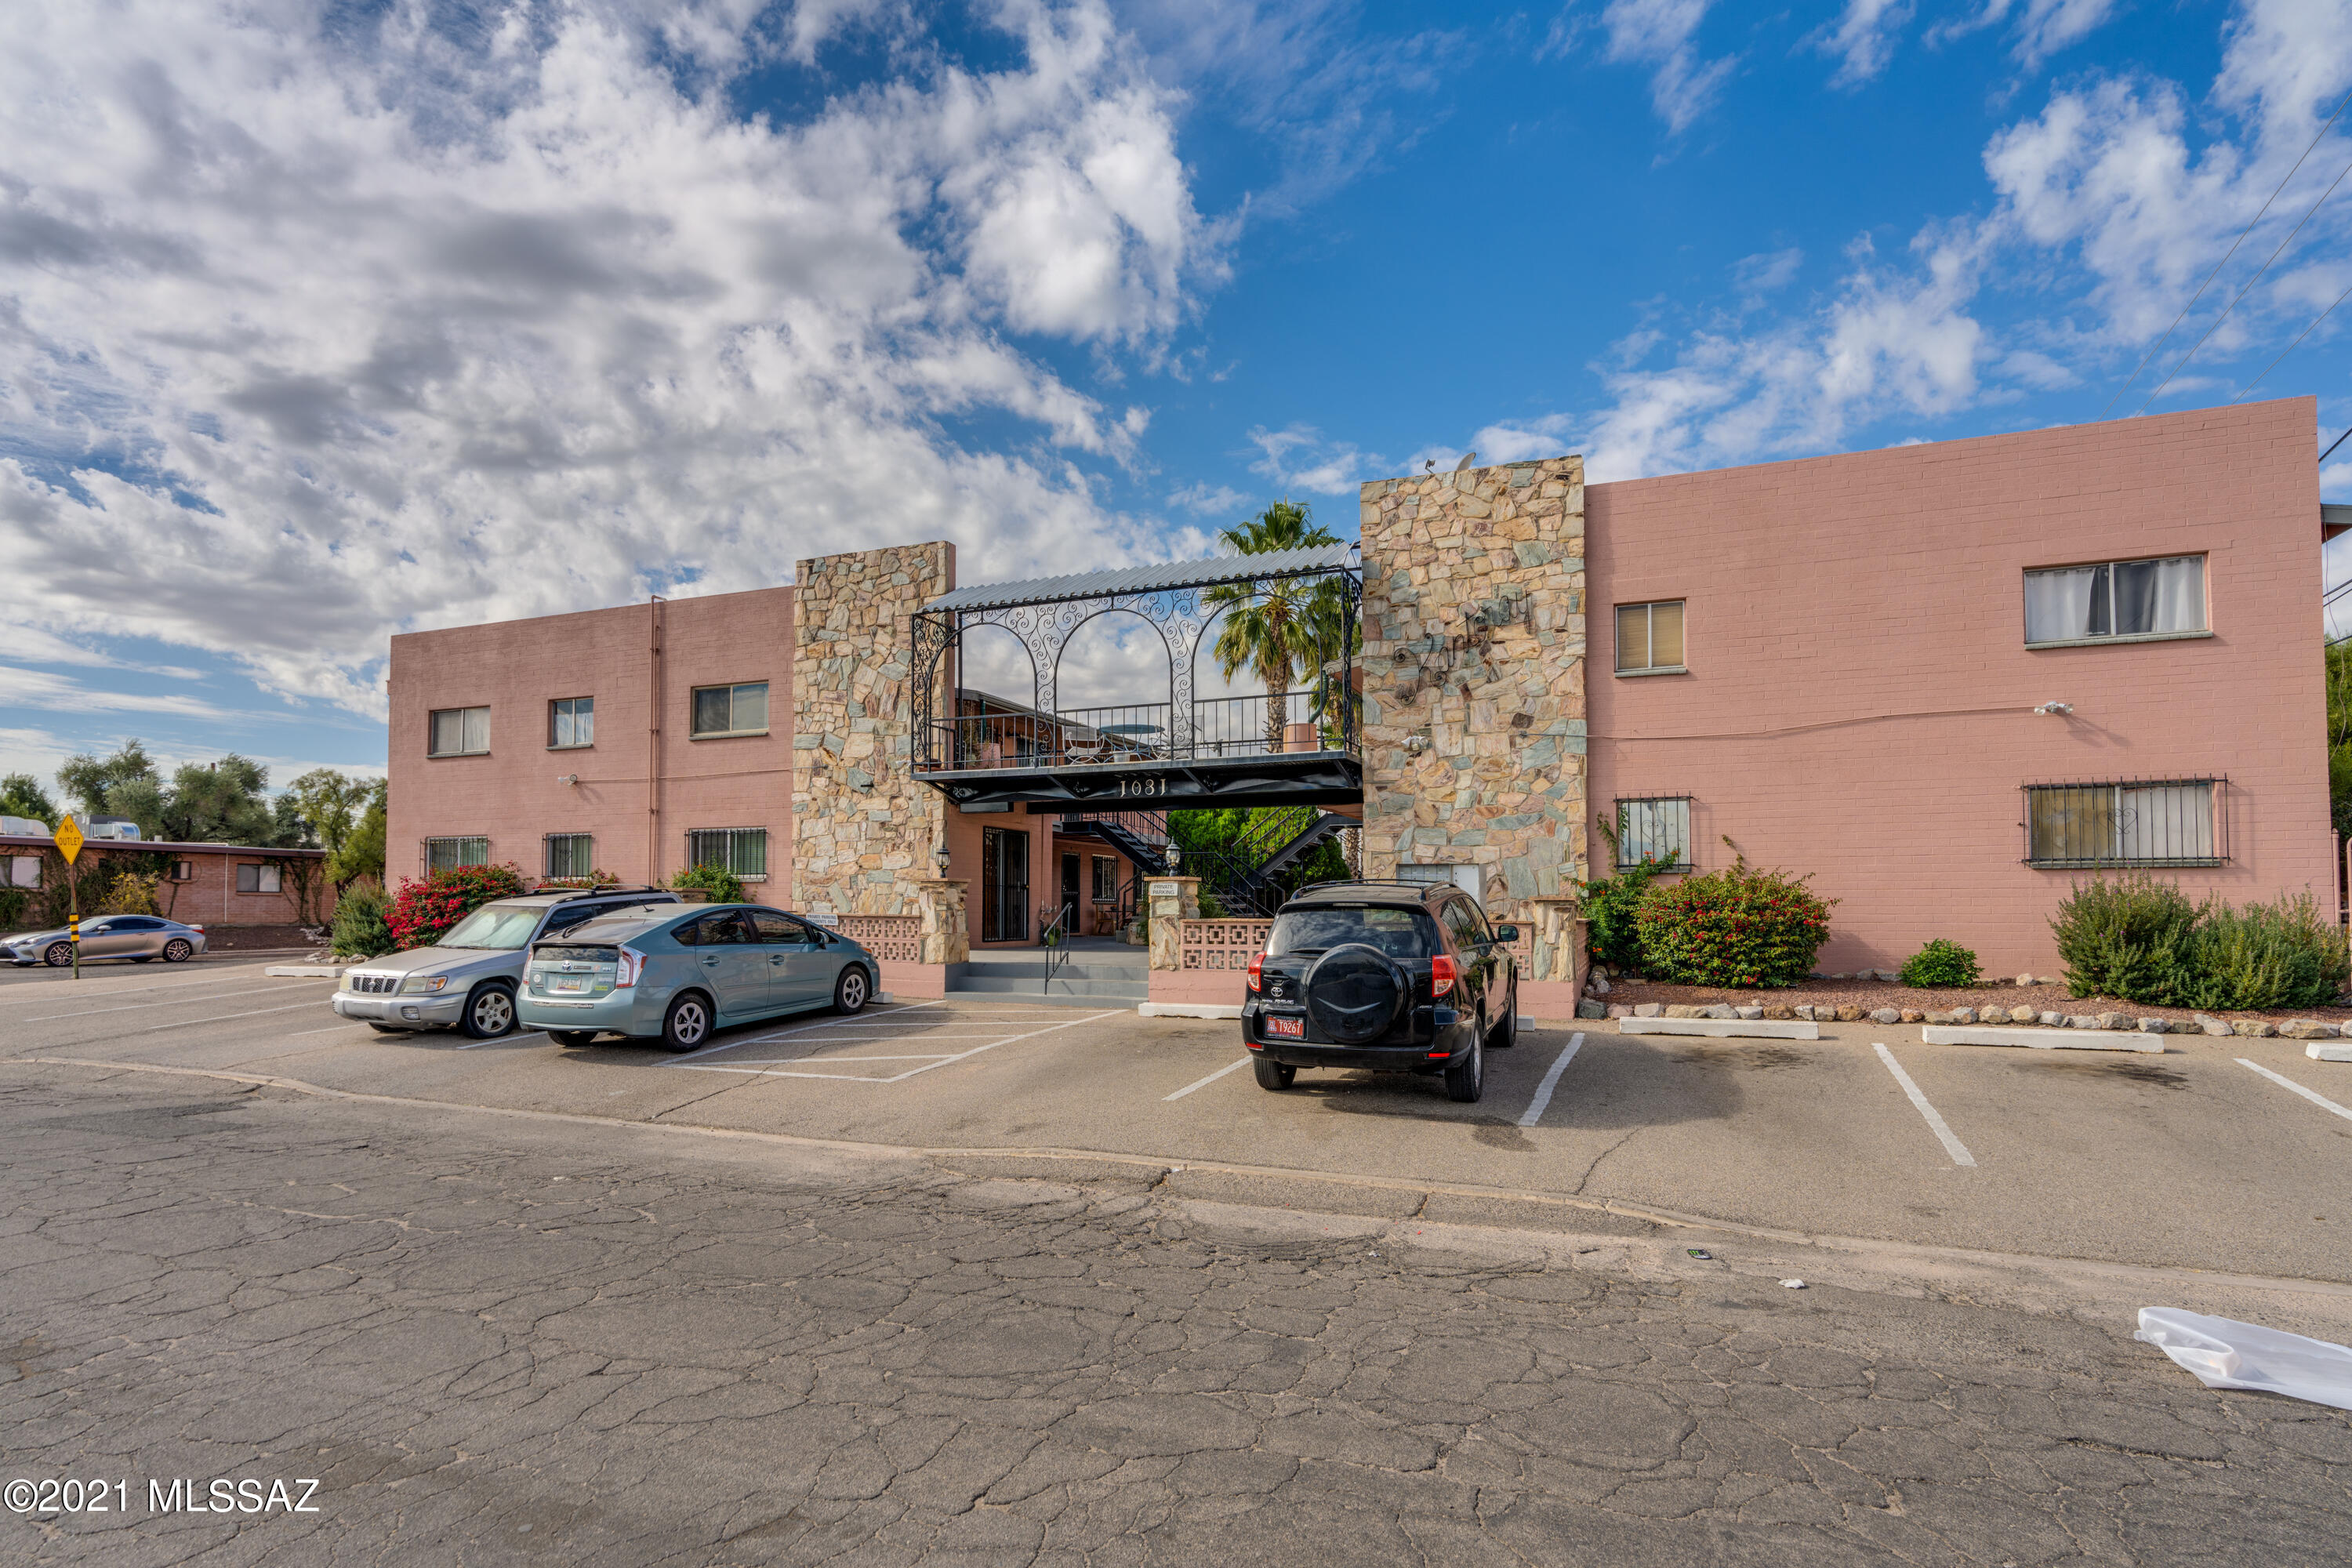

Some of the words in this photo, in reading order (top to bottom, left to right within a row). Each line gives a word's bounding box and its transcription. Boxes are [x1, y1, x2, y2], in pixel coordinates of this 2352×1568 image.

[1120, 779, 1166, 797] 1031
[64, 824, 73, 833] NO
[59, 837, 80, 845] OUTLET
[1279, 1022, 1301, 1033] T9267
